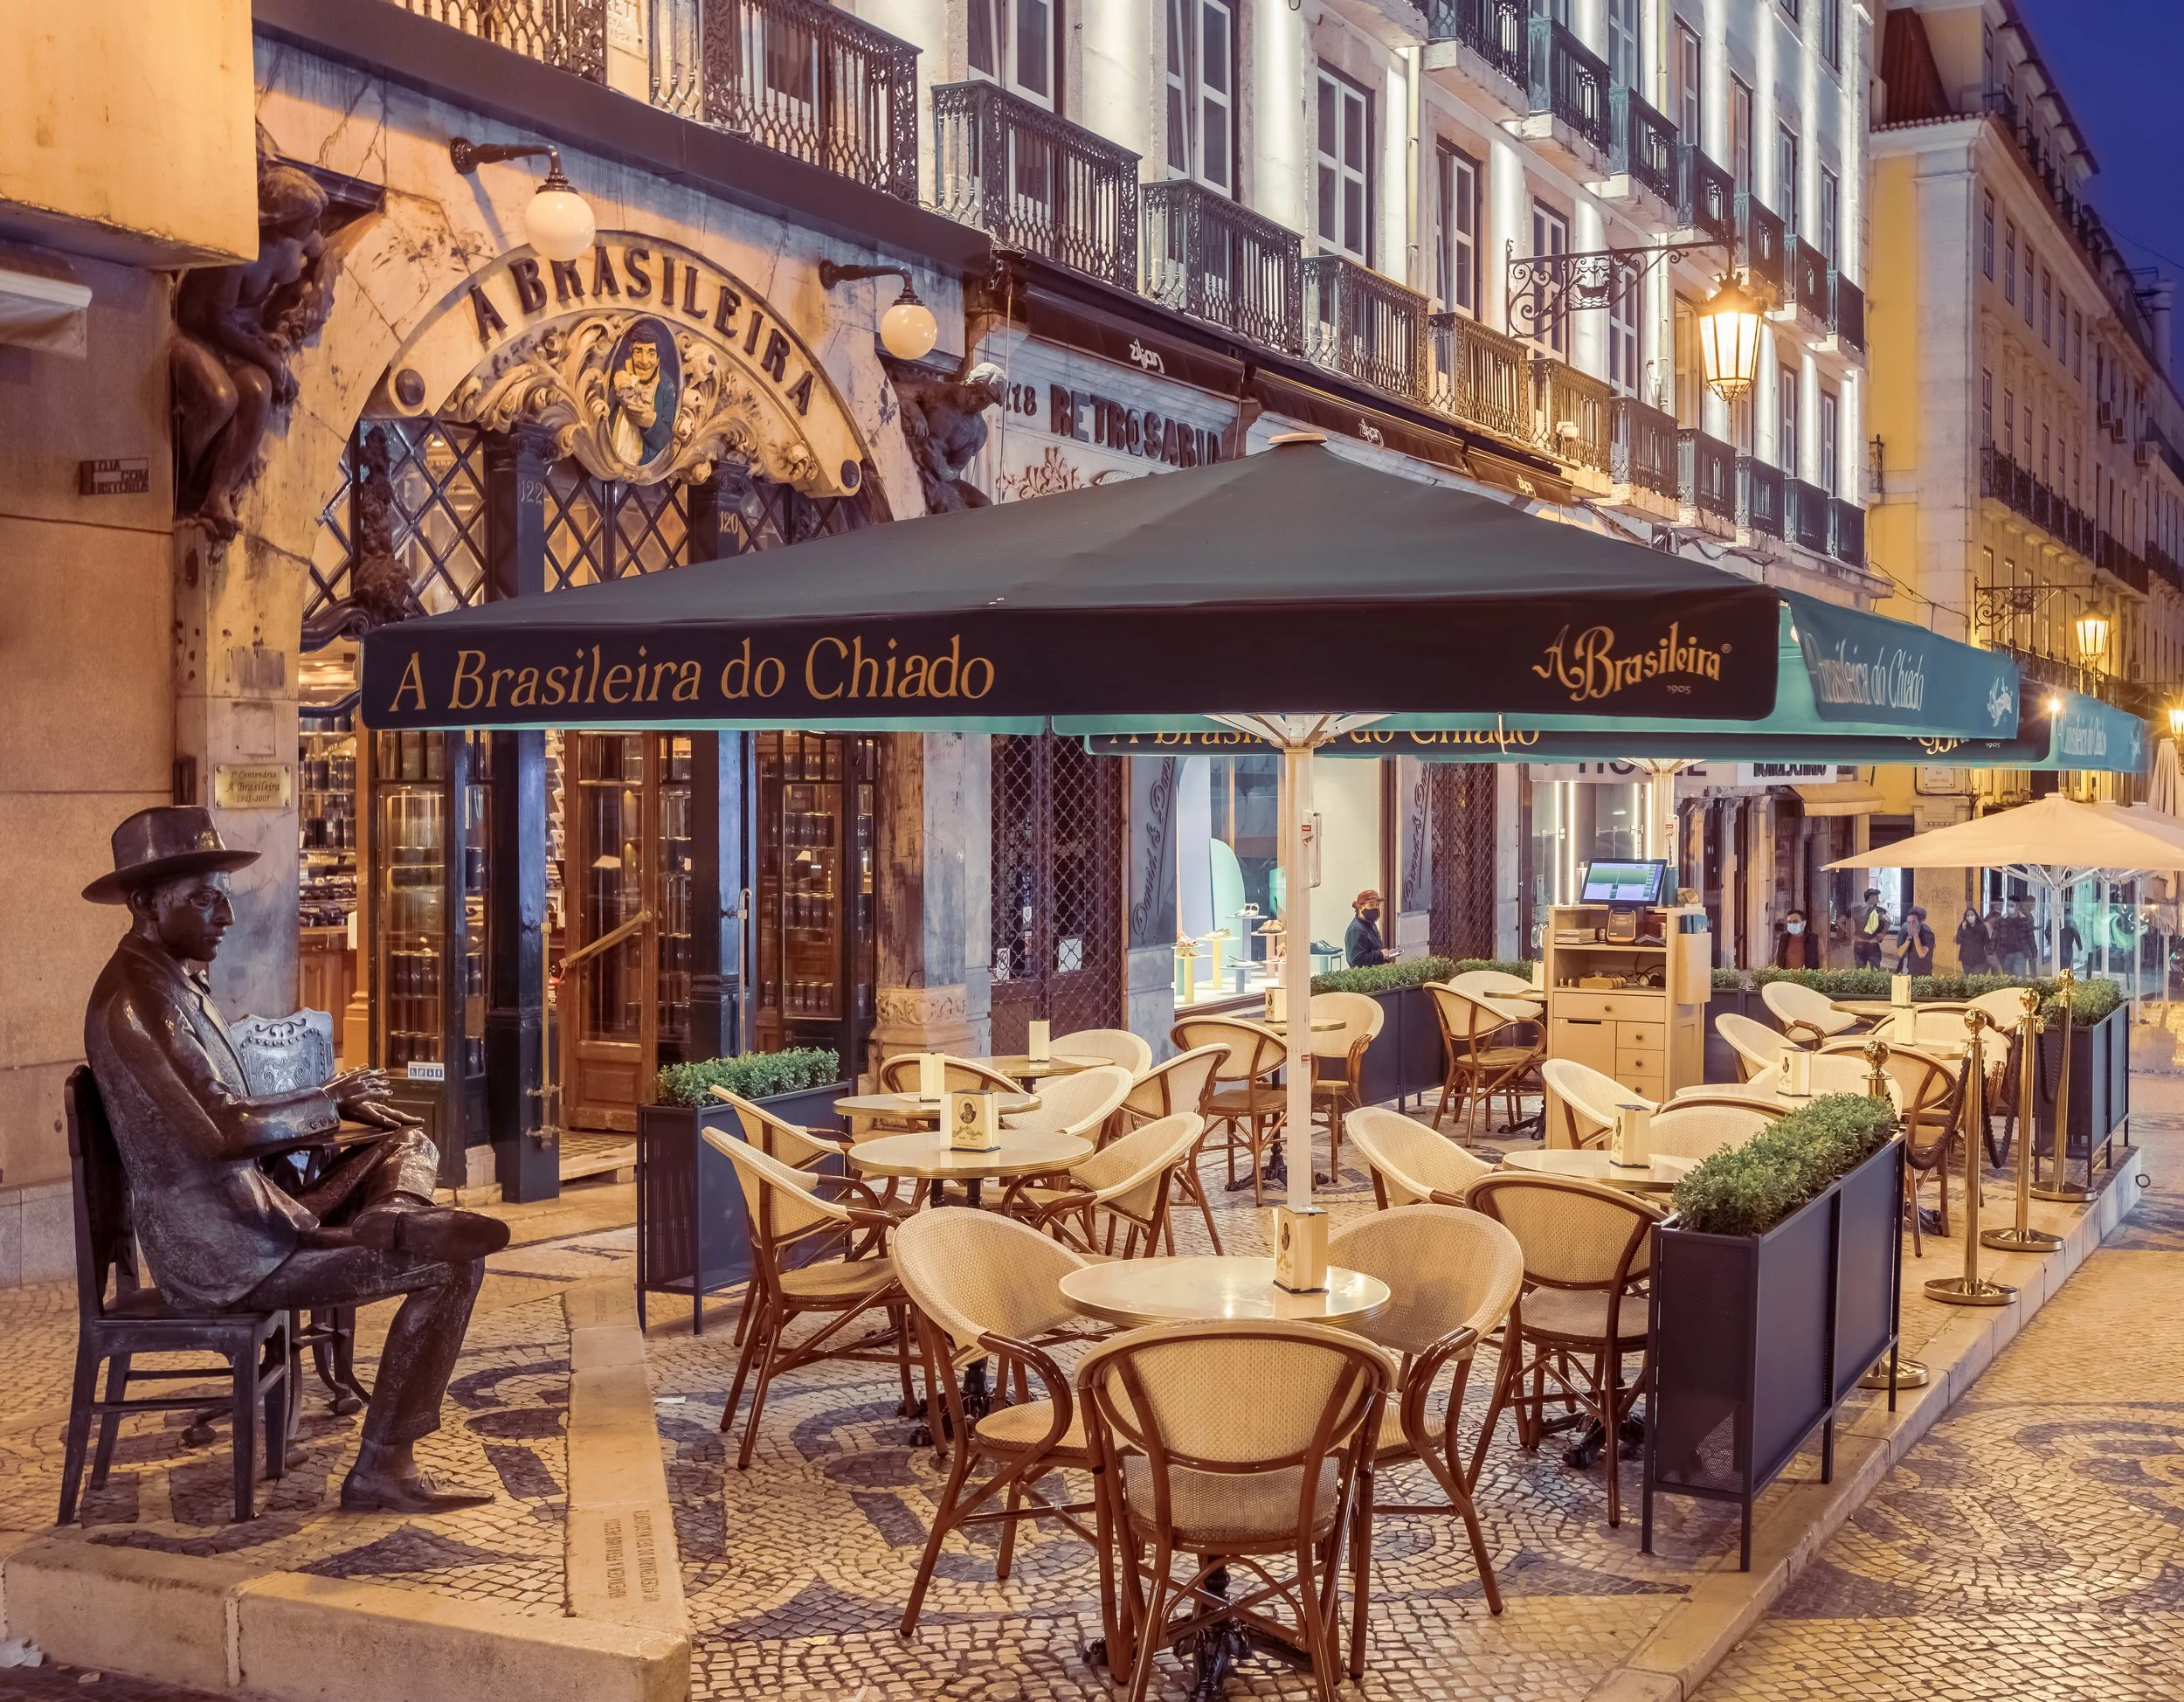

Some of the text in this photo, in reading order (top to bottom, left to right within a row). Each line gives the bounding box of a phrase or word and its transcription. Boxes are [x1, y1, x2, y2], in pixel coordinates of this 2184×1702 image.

[470, 246, 815, 417] A BRASILEIRA
[521, 479, 543, 505] 122
[720, 510, 739, 535] 120
[388, 633, 995, 712] A Brasileira do Chiado
[1531, 620, 1721, 702] A Brasileira
[1665, 684, 1692, 695] 1905
[1888, 648, 1925, 712] Chiado
[225, 781, 280, 793] A Brasileira
[238, 771, 276, 779] Centenário
